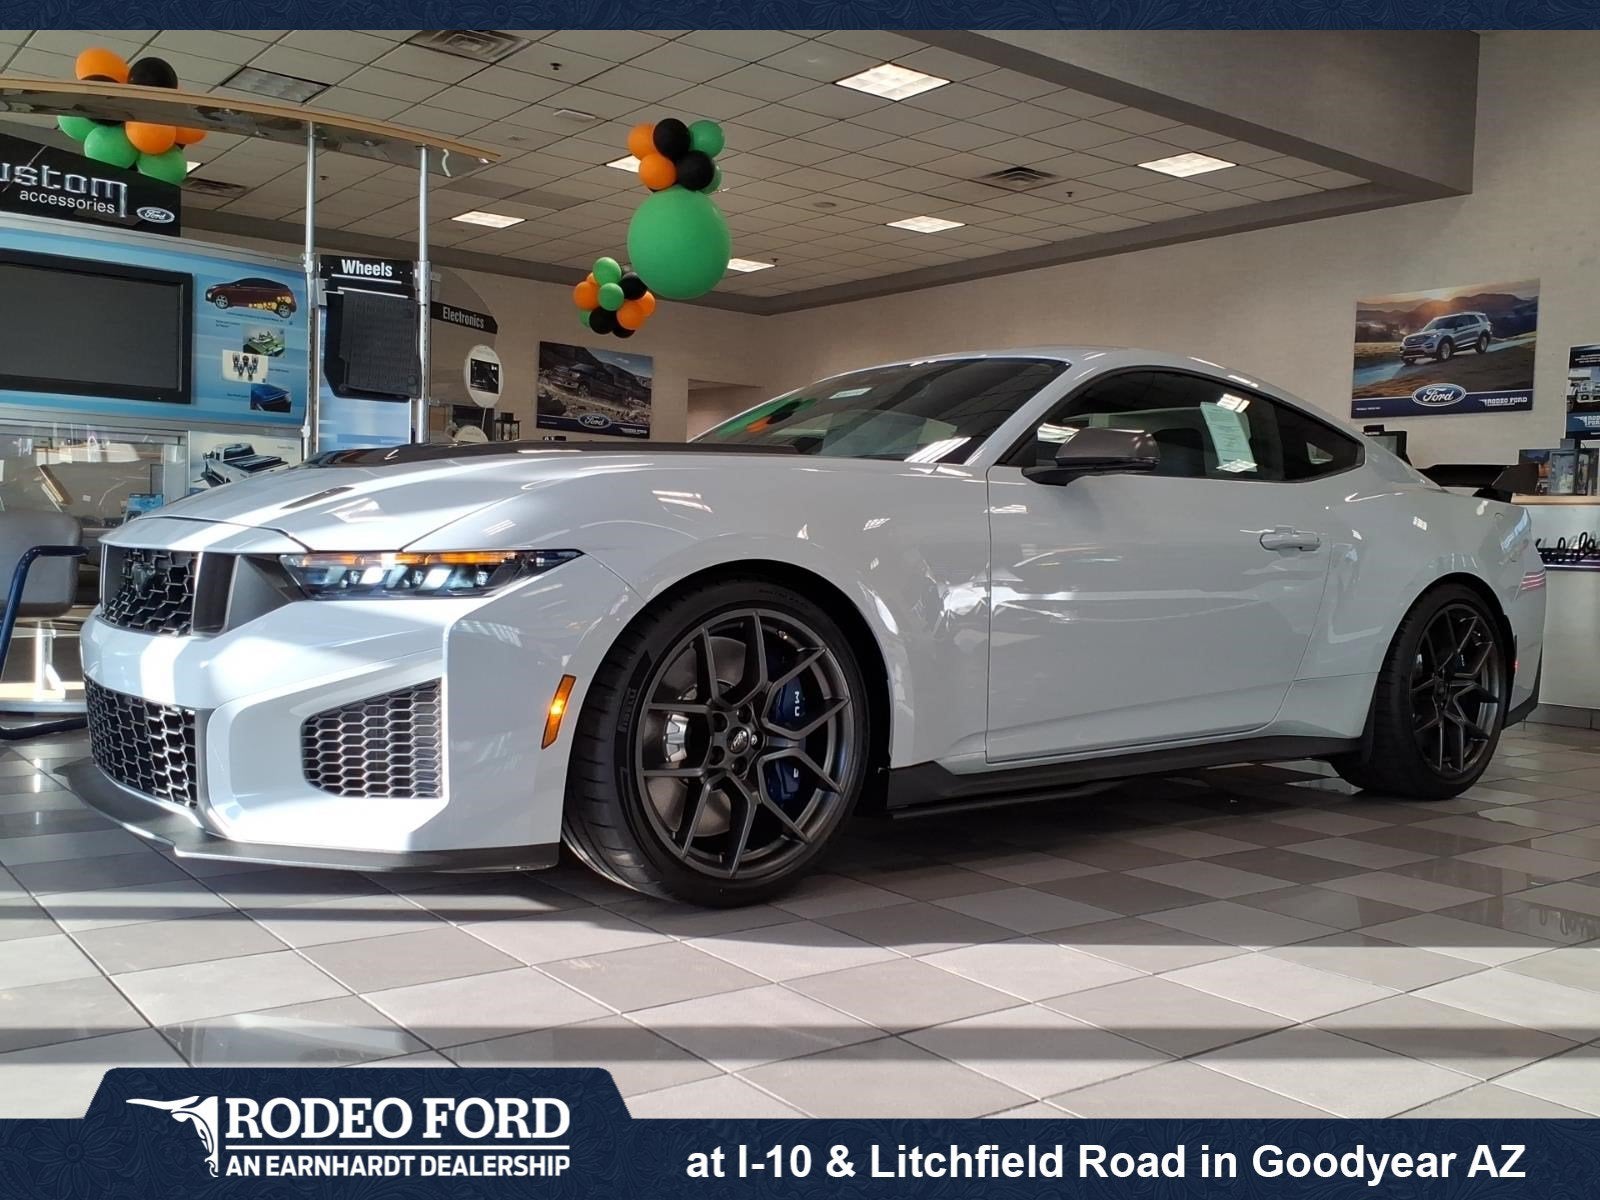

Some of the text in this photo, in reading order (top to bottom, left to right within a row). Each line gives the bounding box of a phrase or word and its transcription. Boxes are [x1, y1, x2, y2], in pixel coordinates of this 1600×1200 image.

[19, 189, 116, 215] accessories
[340, 258, 393, 278] Wheels
[442, 305, 485, 329] Electronics
[1422, 387, 1454, 403] Ford
